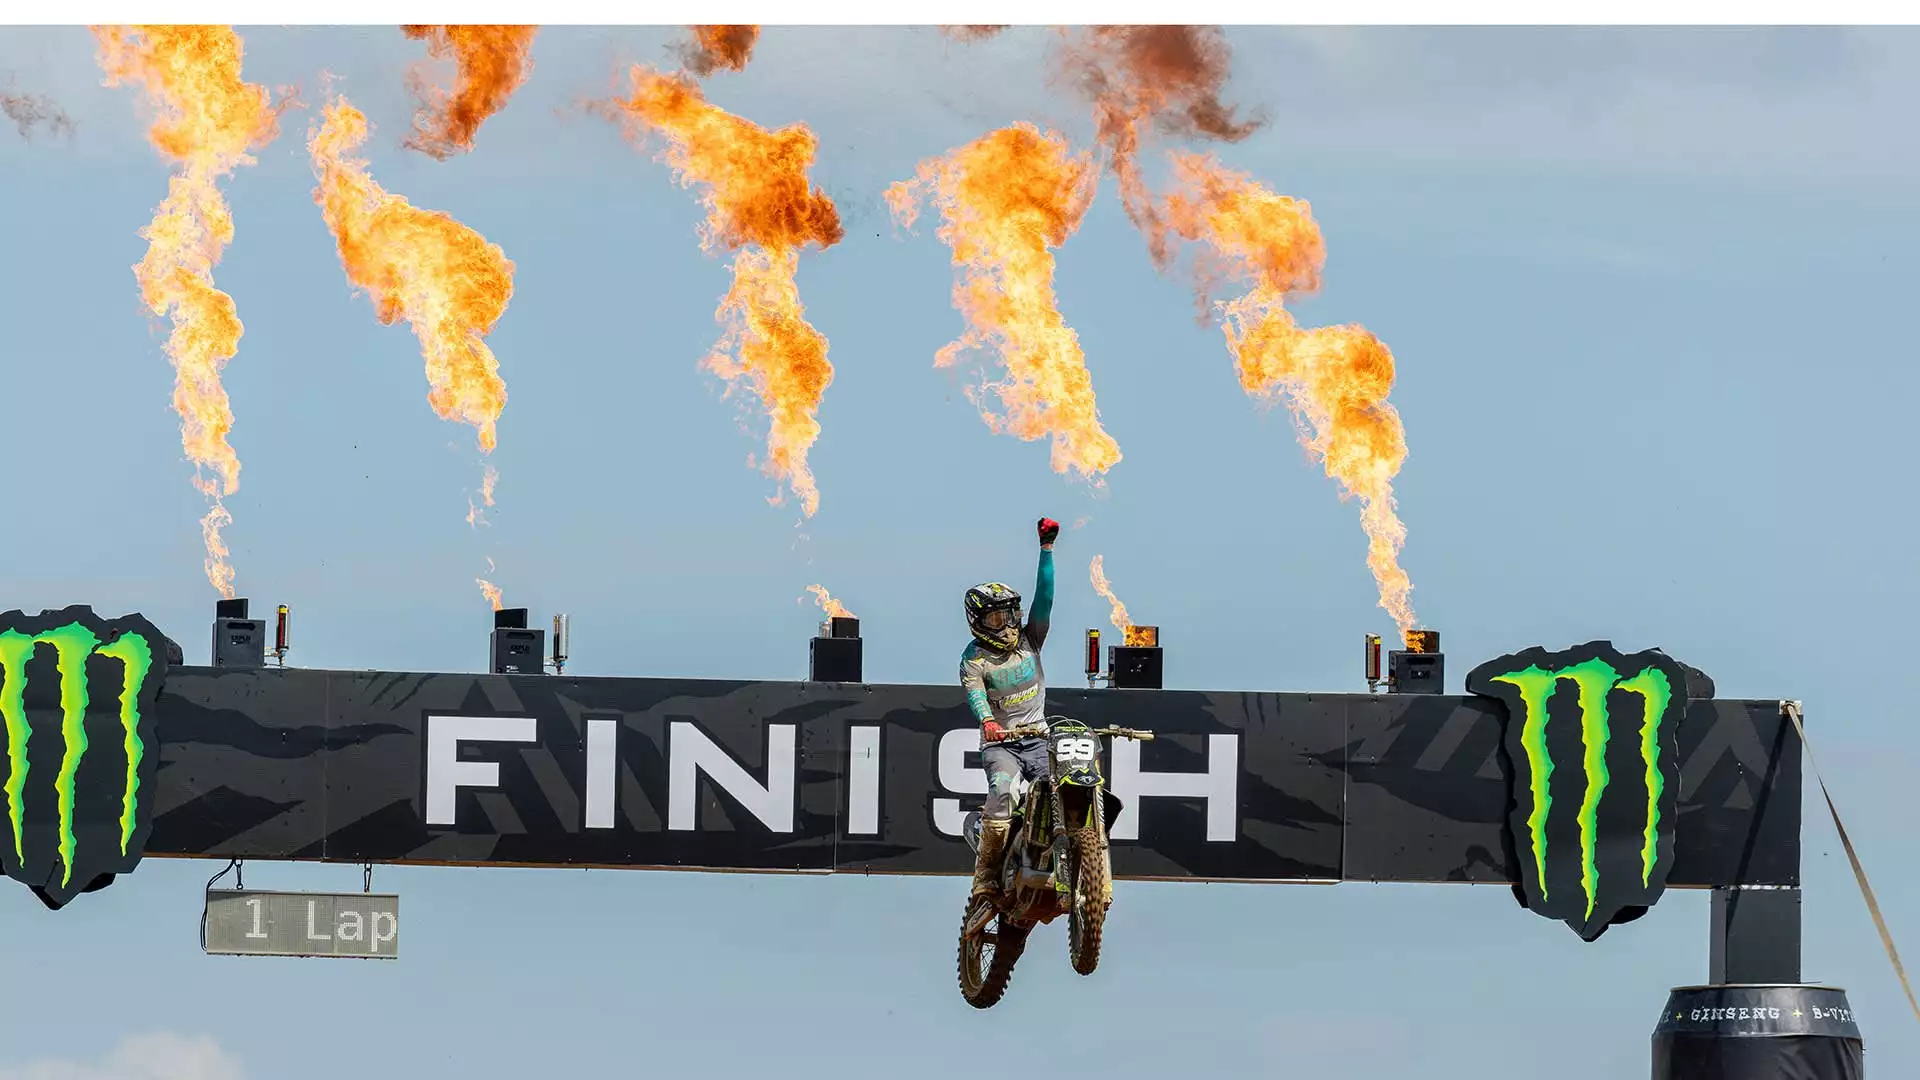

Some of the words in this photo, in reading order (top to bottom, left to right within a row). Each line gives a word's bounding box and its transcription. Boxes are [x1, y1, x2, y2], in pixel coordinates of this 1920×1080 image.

[1056, 738, 1095, 762] 99
[245, 899, 268, 939] 1
[307, 900, 397, 952] Lap
[1690, 1006, 1780, 1023] GINSENG
